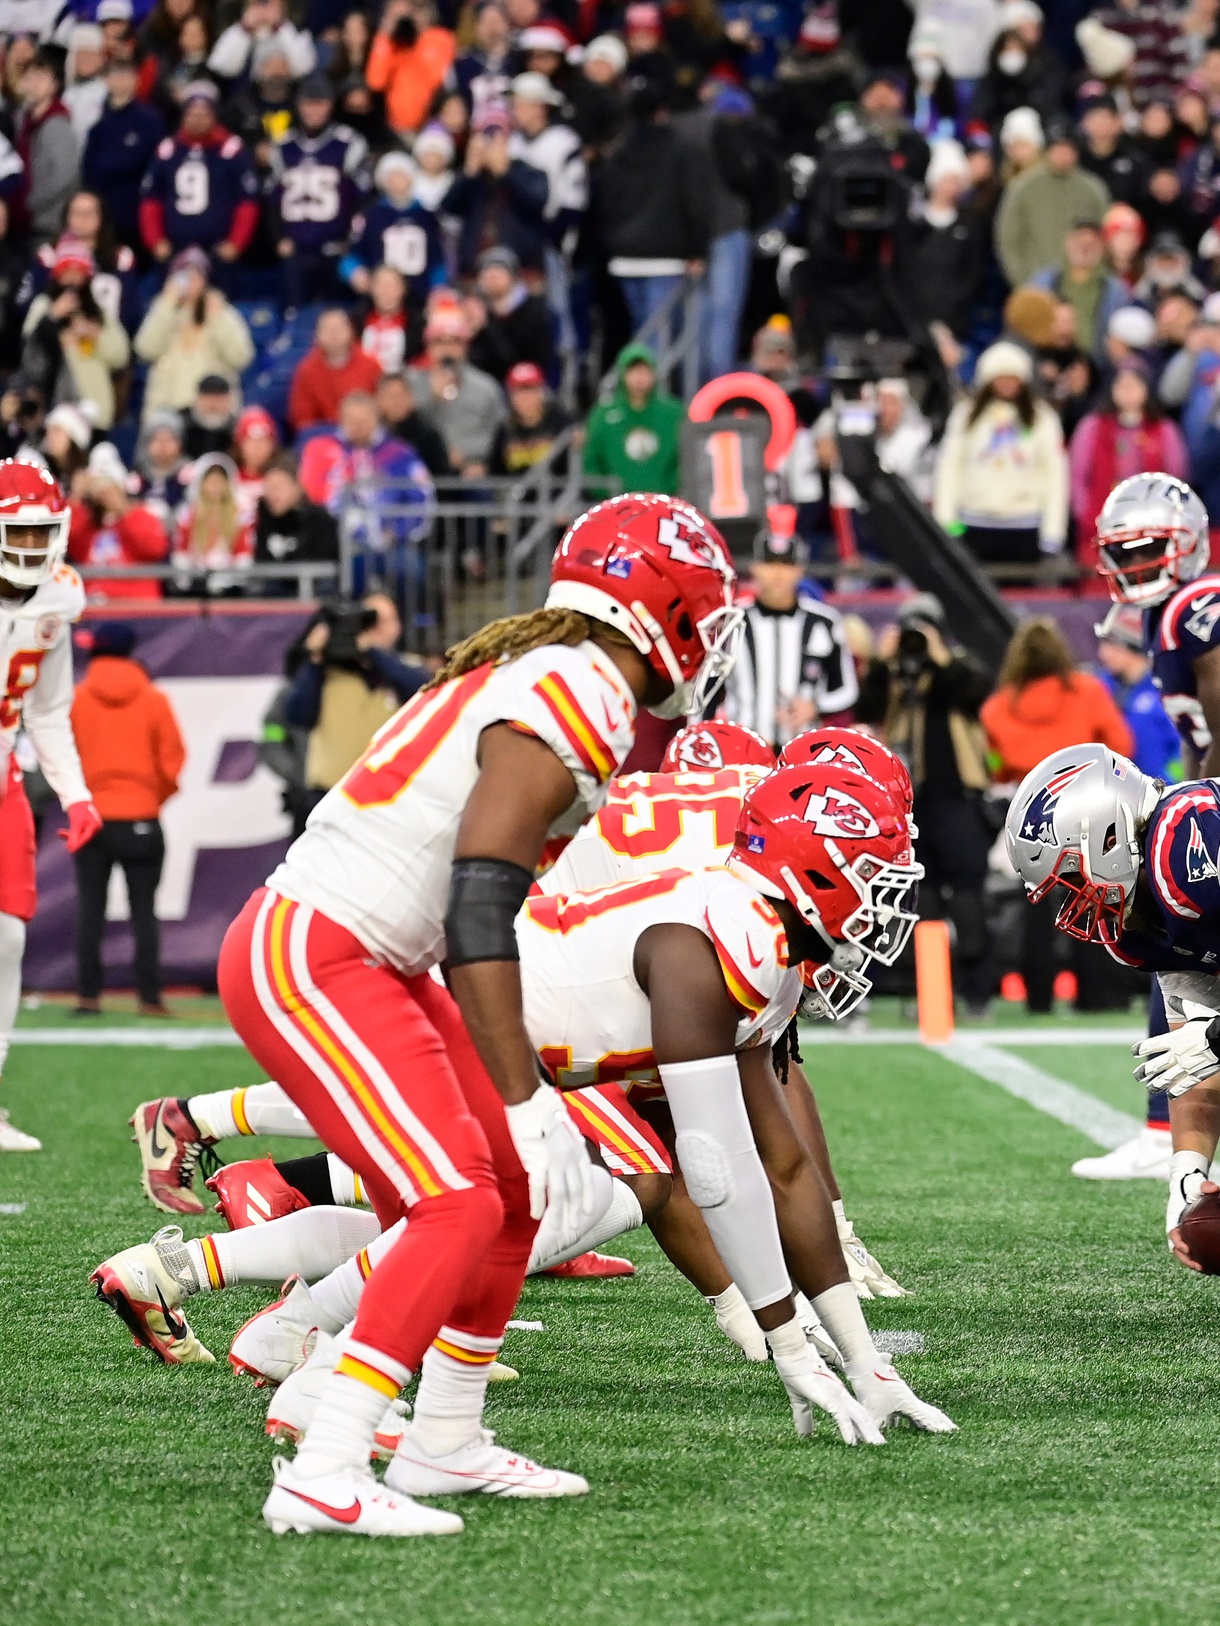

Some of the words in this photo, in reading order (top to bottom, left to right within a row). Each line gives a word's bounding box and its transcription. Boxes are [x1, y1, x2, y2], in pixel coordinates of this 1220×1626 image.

[174, 160, 210, 216] 9
[280, 166, 341, 222] 25
[382, 224, 428, 277] 10
[705, 430, 749, 518] 1
[821, 796, 872, 837] KC
